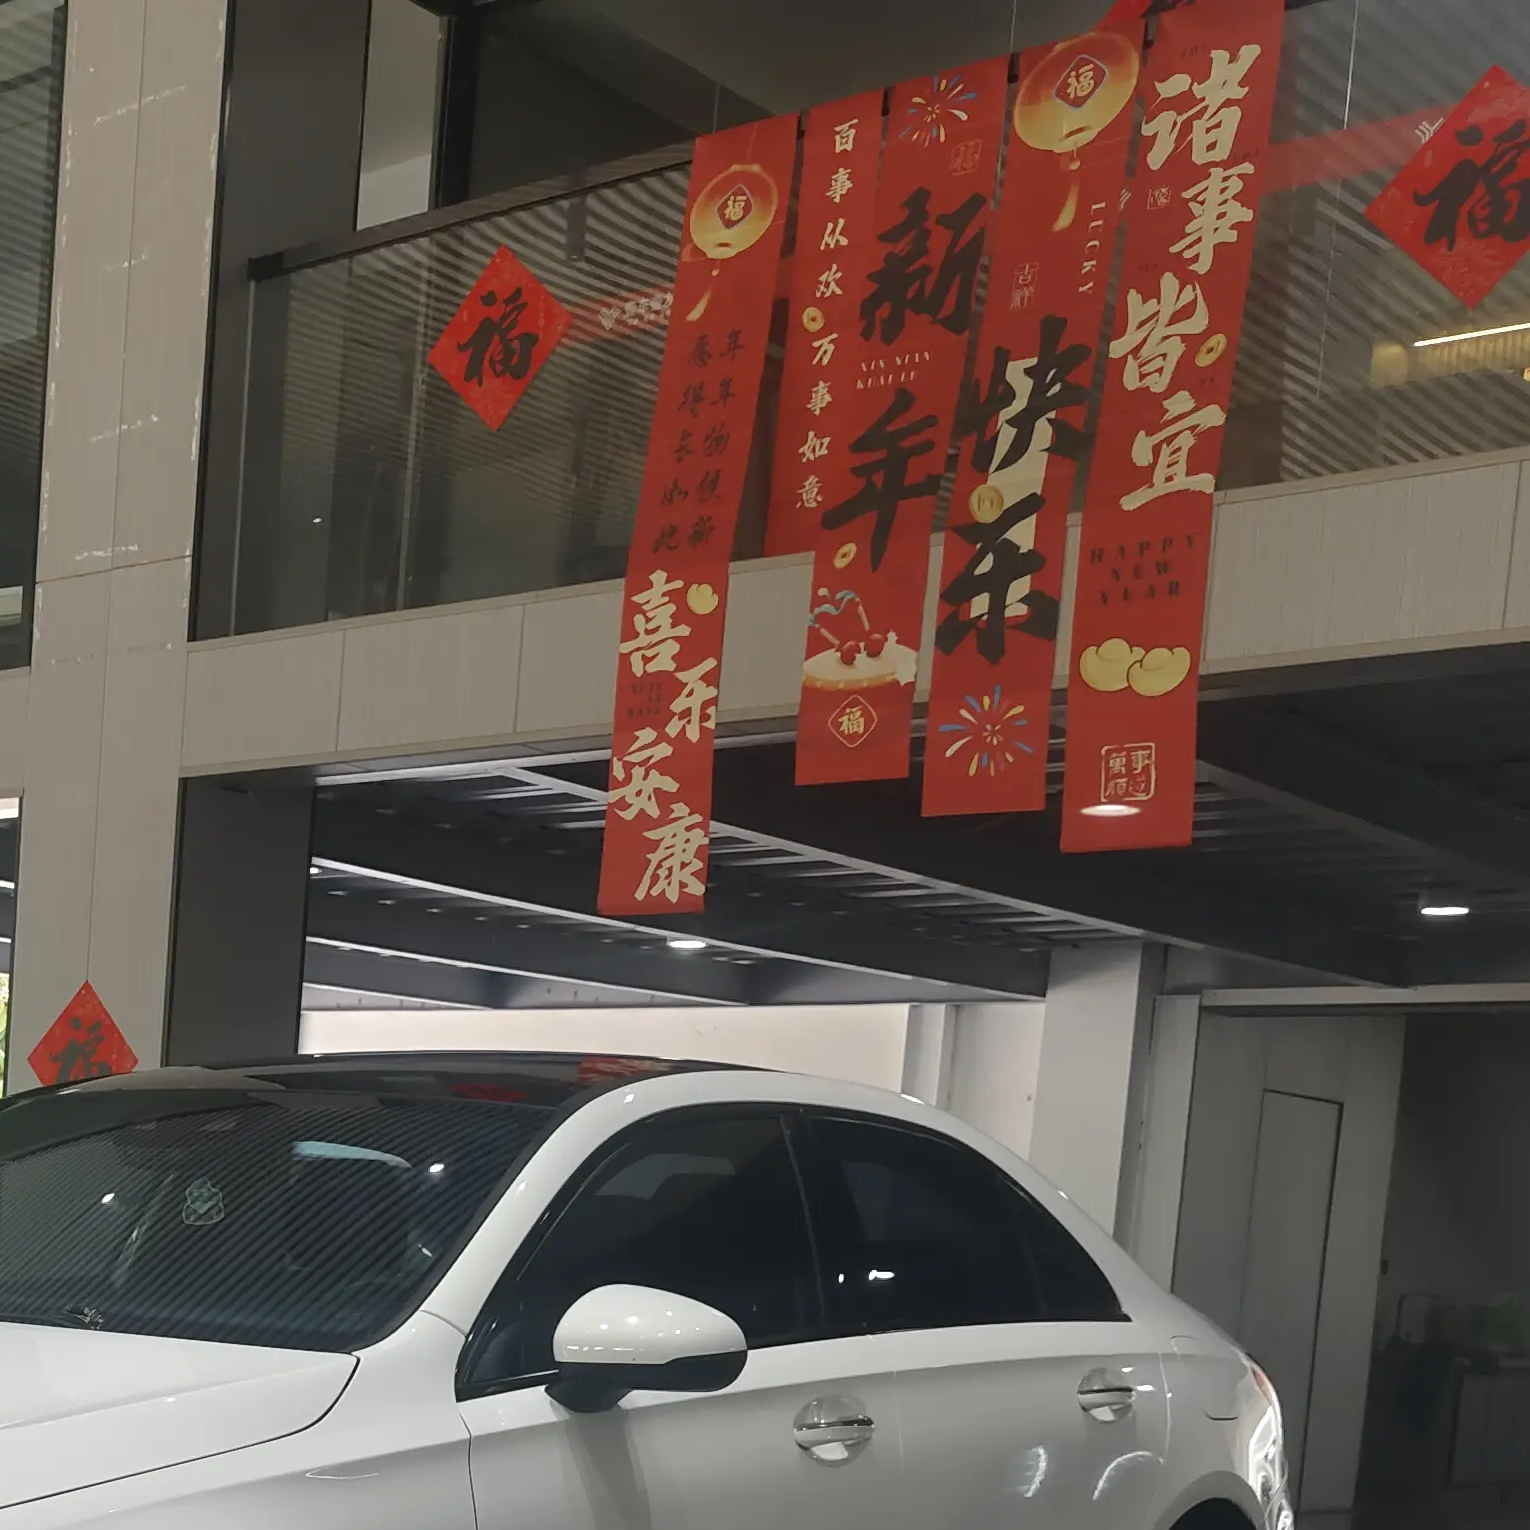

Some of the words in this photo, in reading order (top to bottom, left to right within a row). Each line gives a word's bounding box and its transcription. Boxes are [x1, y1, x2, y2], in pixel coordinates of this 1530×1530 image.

[1067, 64, 1095, 98] 福
[724, 195, 747, 222] 福
[814, 118, 859, 298] 百事从欢
[1412, 118, 1530, 252] 福
[1078, 202, 1106, 293] LUCKY
[1109, 44, 1261, 511] 诸事皆宜
[457, 286, 540, 389] 福
[820, 187, 988, 574] 新年
[795, 333, 839, 508] 万事如意
[934, 316, 1092, 666] 快乐
[1090, 533, 1200, 565] HAPPY
[1099, 580, 1180, 608] YEAR
[1111, 559, 1171, 582] NEW
[608, 569, 719, 903] 喜乐安康
[838, 705, 867, 736] 福
[50, 1017, 113, 1083] 福
